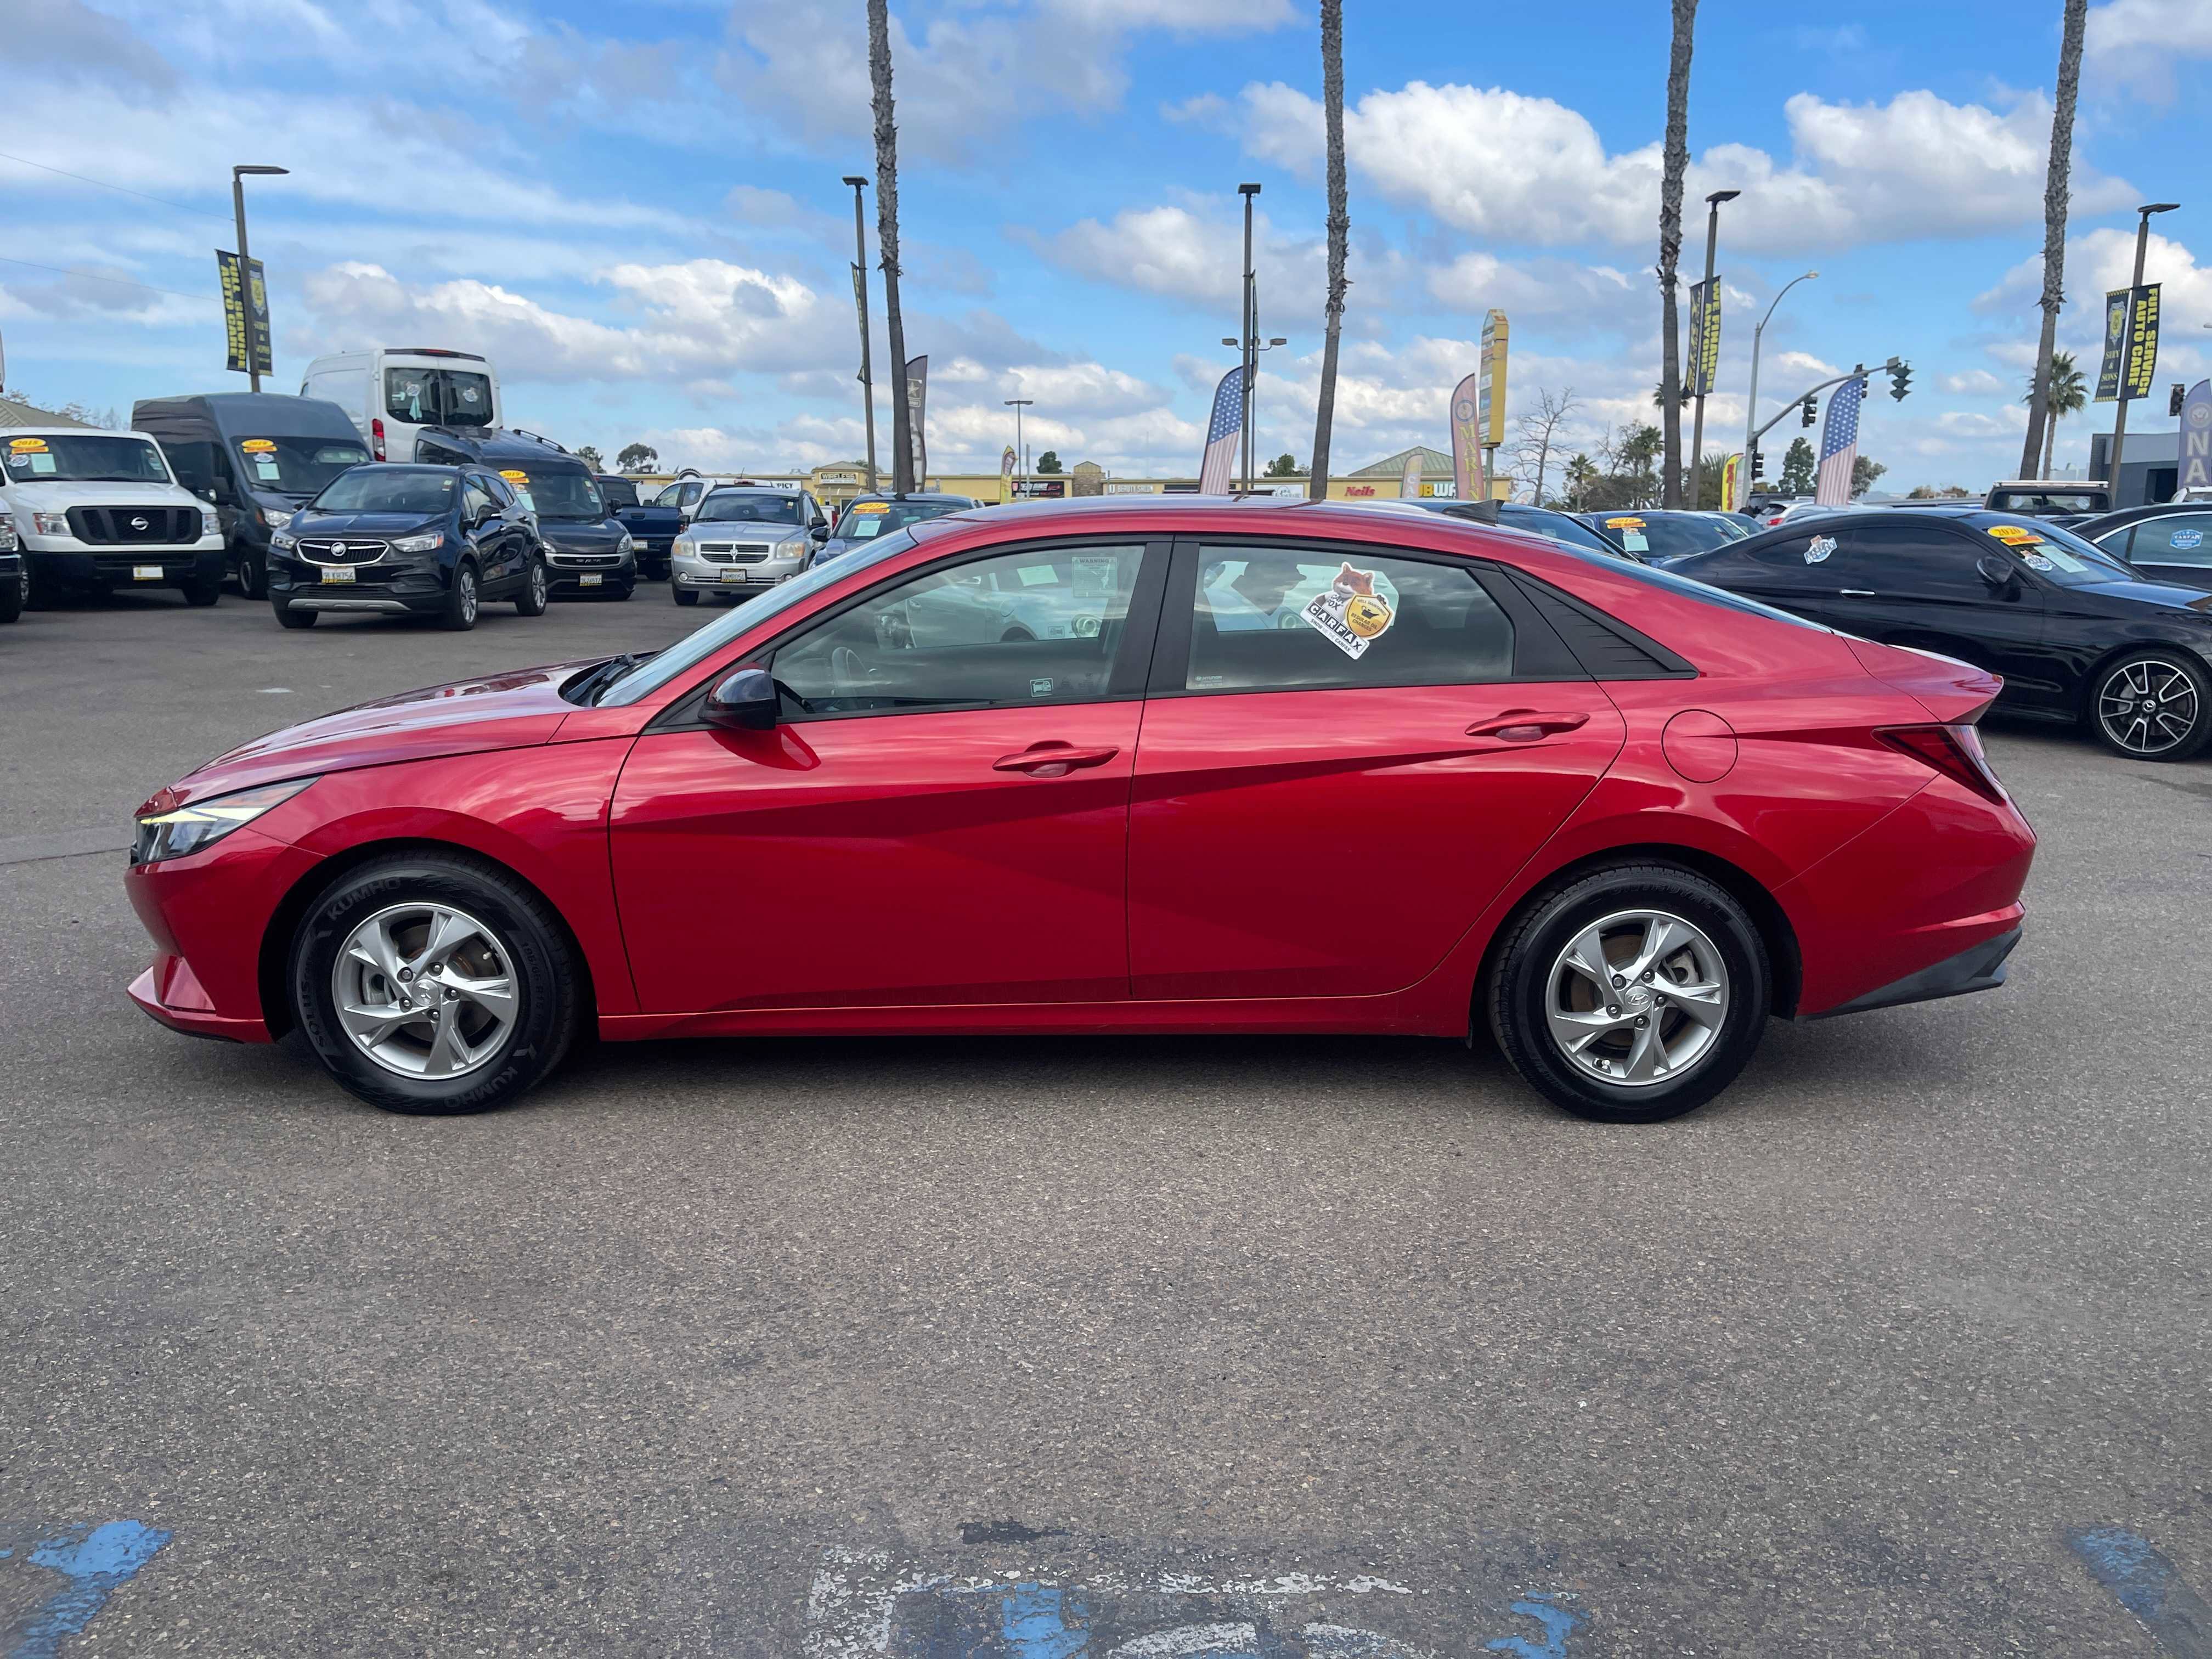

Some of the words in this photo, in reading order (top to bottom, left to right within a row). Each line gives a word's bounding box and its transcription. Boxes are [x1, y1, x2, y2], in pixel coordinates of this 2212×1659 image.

[221, 265, 234, 311] AUTO
[1712, 281, 1719, 312] WE
[2147, 288, 2158, 323] FULL
[227, 313, 238, 356] CARE
[235, 301, 246, 368] SERVICE
[1701, 303, 1711, 373] ANYONE
[2134, 300, 2147, 342] AUTO
[1706, 315, 1719, 390] FINANCE
[2128, 345, 2143, 386] CARE
[2137, 330, 2156, 395] SERVICE
[1406, 474, 1416, 498] CA
[1310, 605, 1362, 651] CARFAX
[1311, 619, 1323, 629] SHOW
[1335, 637, 1351, 652] CARFAX
[1351, 613, 1370, 627] REGULAR
[1352, 618, 1372, 631] CHANGES
[328, 878, 401, 922] KUMHO
[443, 1066, 520, 1108] KUMHO
